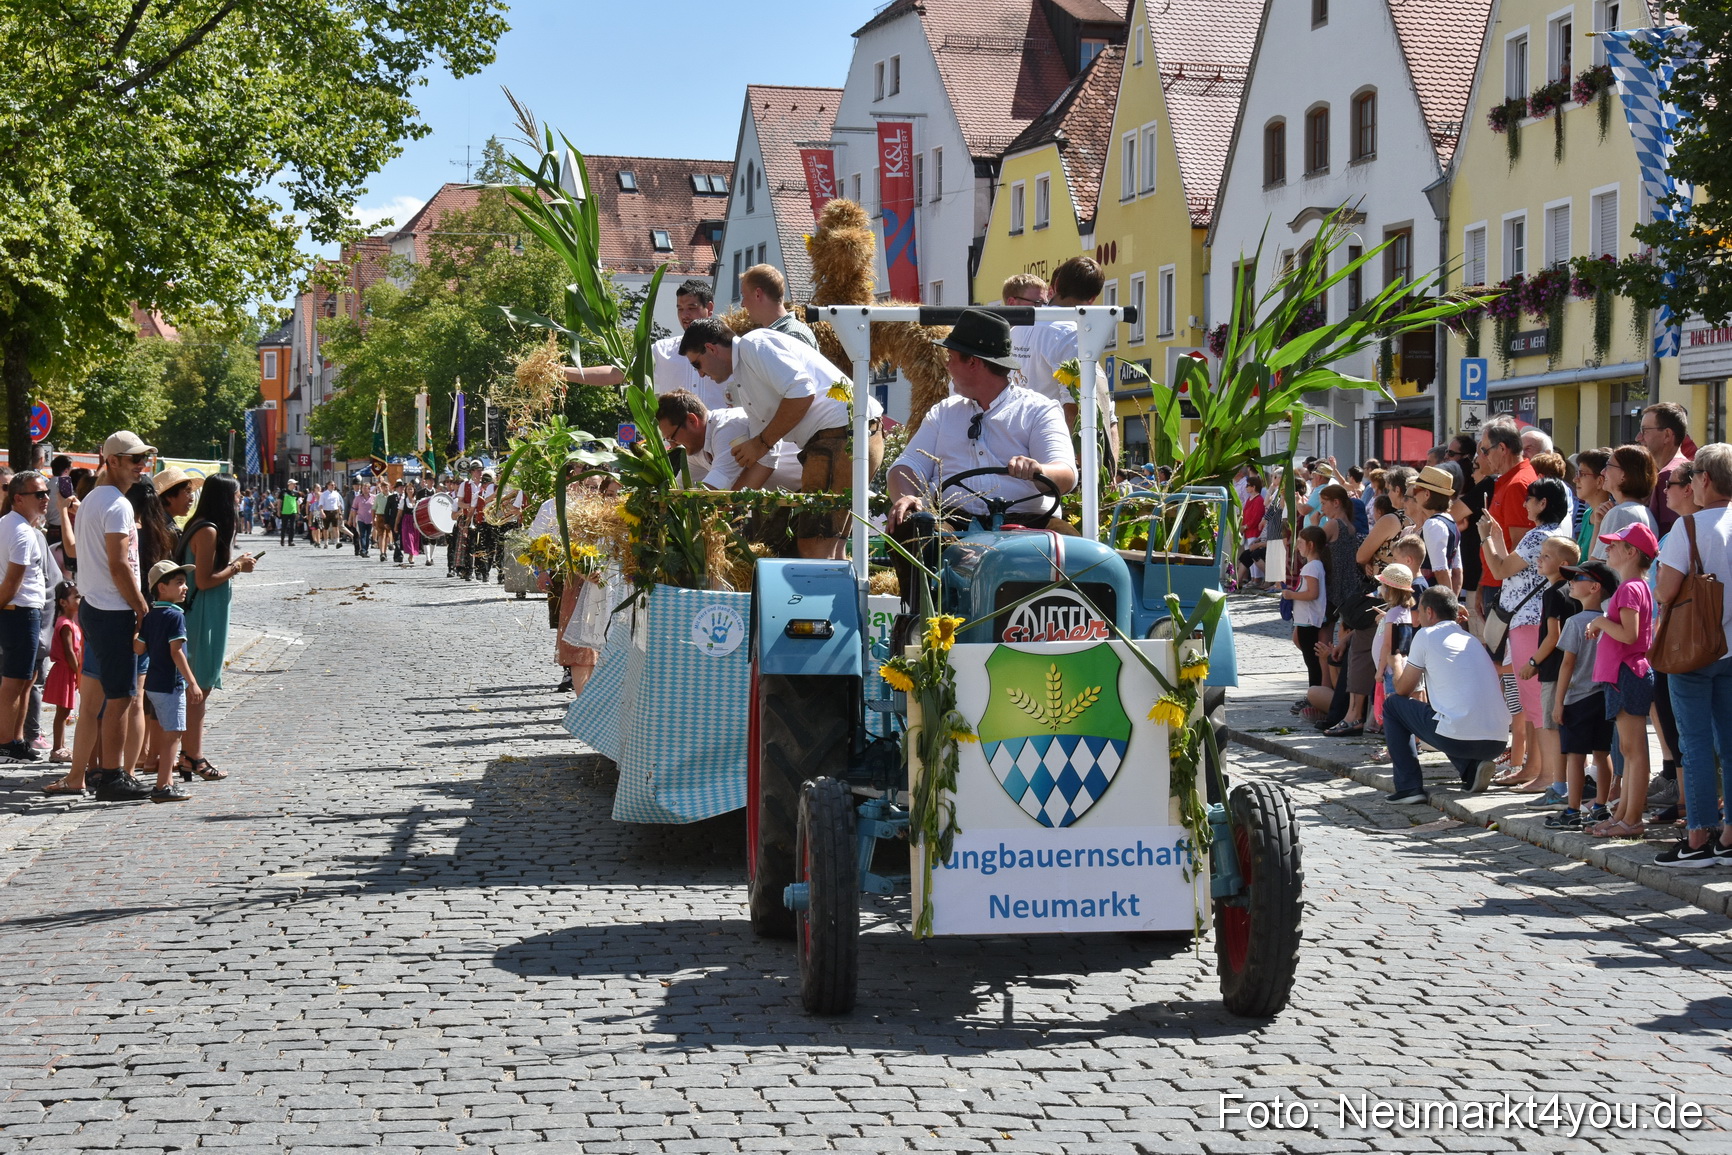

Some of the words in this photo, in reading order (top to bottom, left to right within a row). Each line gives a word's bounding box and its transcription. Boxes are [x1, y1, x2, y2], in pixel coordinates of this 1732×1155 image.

[884, 129, 904, 178] K&L
[901, 129, 910, 178] RUPPERT
[1530, 335, 1546, 348] MEHR
[1691, 327, 1715, 346] RIALTO
[1466, 363, 1482, 396] P
[1493, 399, 1513, 413] WOLLE
[301, 455, 309, 465] T
[1002, 619, 1110, 642] Eicher
[932, 840, 1197, 876] ungbauernschaft
[989, 891, 1141, 919] Neumarkt
